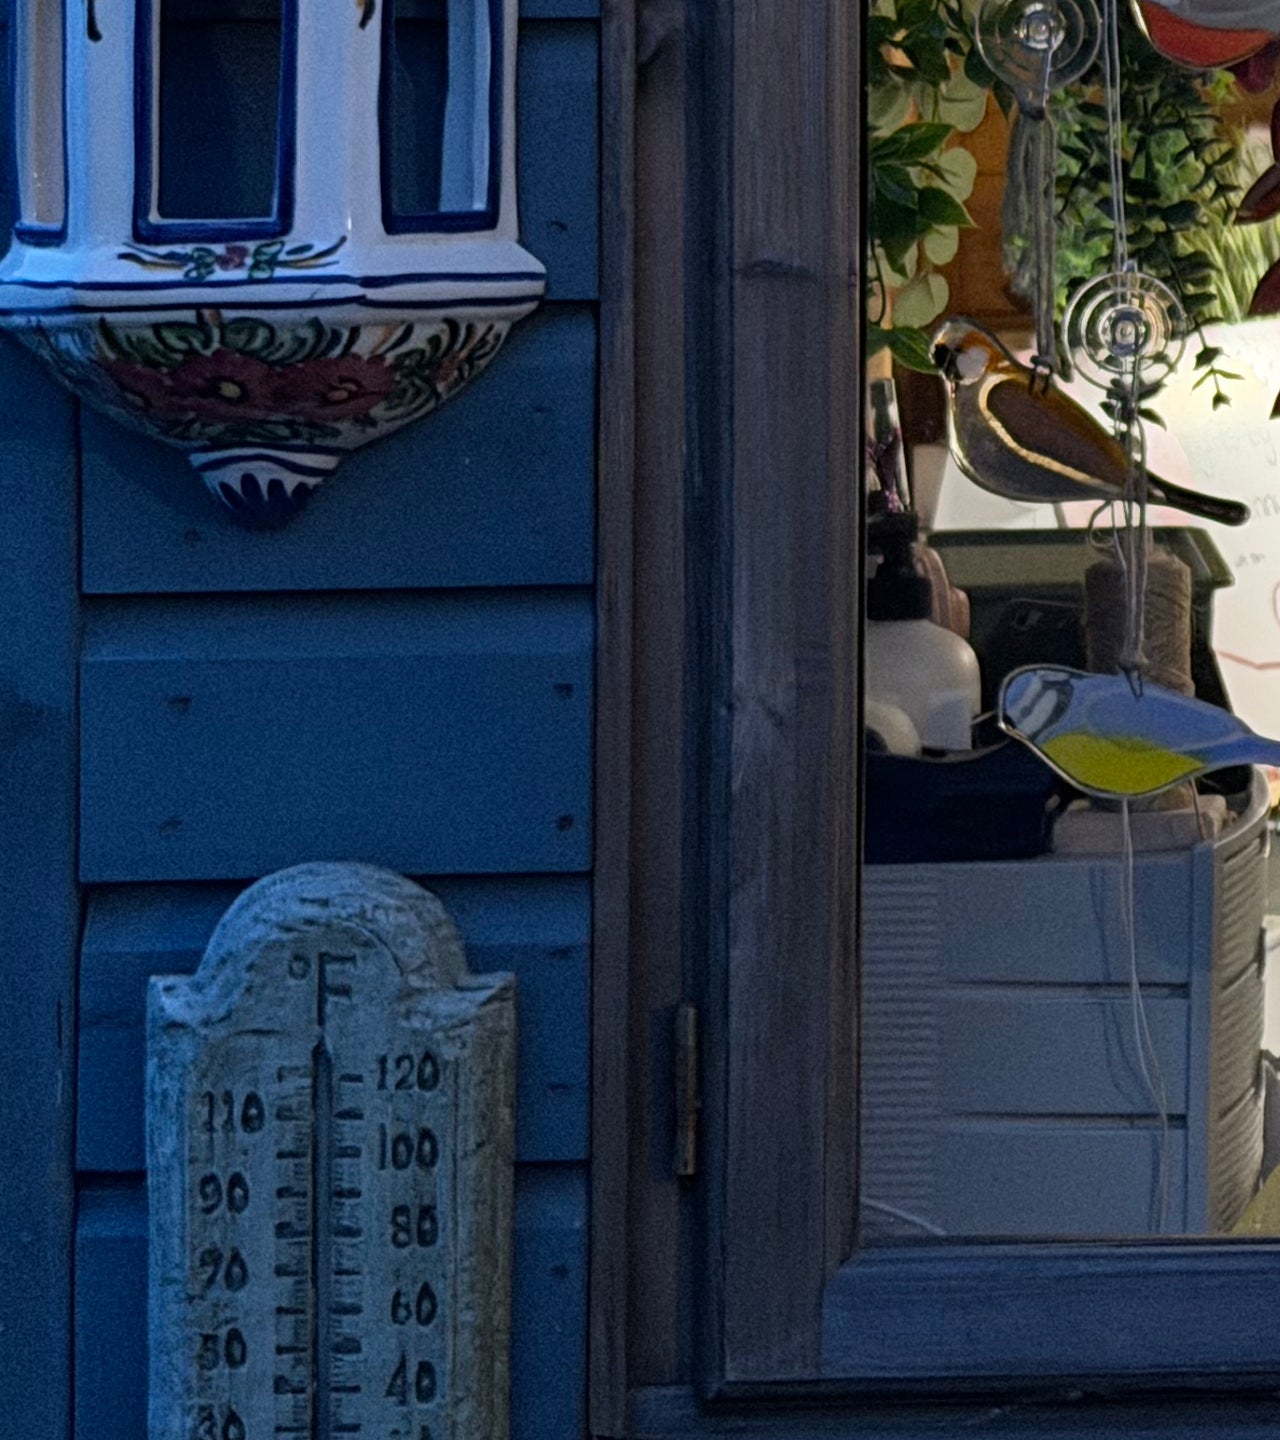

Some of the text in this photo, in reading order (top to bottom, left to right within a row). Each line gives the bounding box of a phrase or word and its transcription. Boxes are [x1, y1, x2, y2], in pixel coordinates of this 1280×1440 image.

[376, 1050, 440, 1093] 120
[200, 1091, 266, 1134] 110
[376, 1126, 440, 1172] 100
[199, 1171, 250, 1216] 90
[390, 1203, 440, 1249] 80
[198, 1245, 250, 1293] 70
[390, 1280, 439, 1327] 60
[198, 1326, 247, 1372] 50
[384, 1351, 438, 1408] 40
